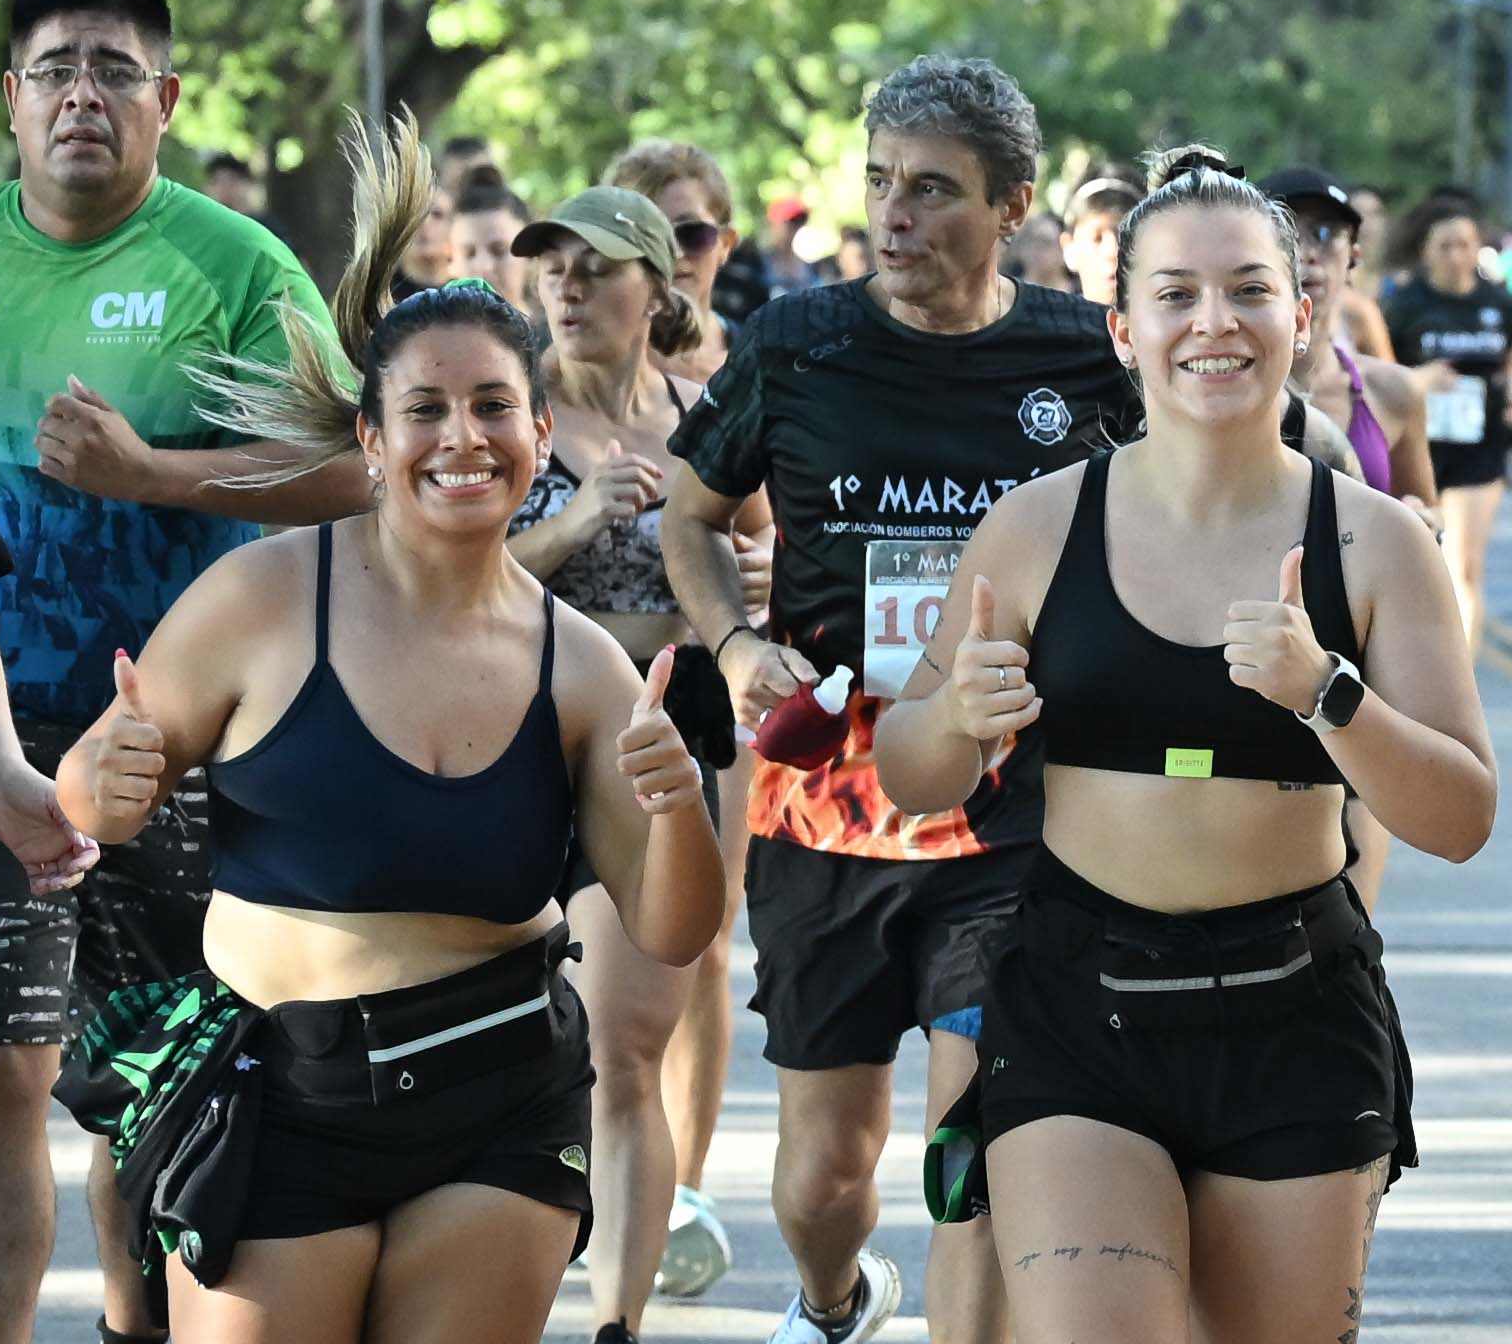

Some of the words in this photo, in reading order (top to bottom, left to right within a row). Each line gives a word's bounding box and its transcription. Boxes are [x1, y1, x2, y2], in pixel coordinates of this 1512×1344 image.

[91, 291, 167, 328] CM
[1036, 406, 1056, 425] 27
[877, 467, 1040, 514] MARAT
[887, 525, 952, 537] BOMBEROS
[918, 553, 960, 573] MAR
